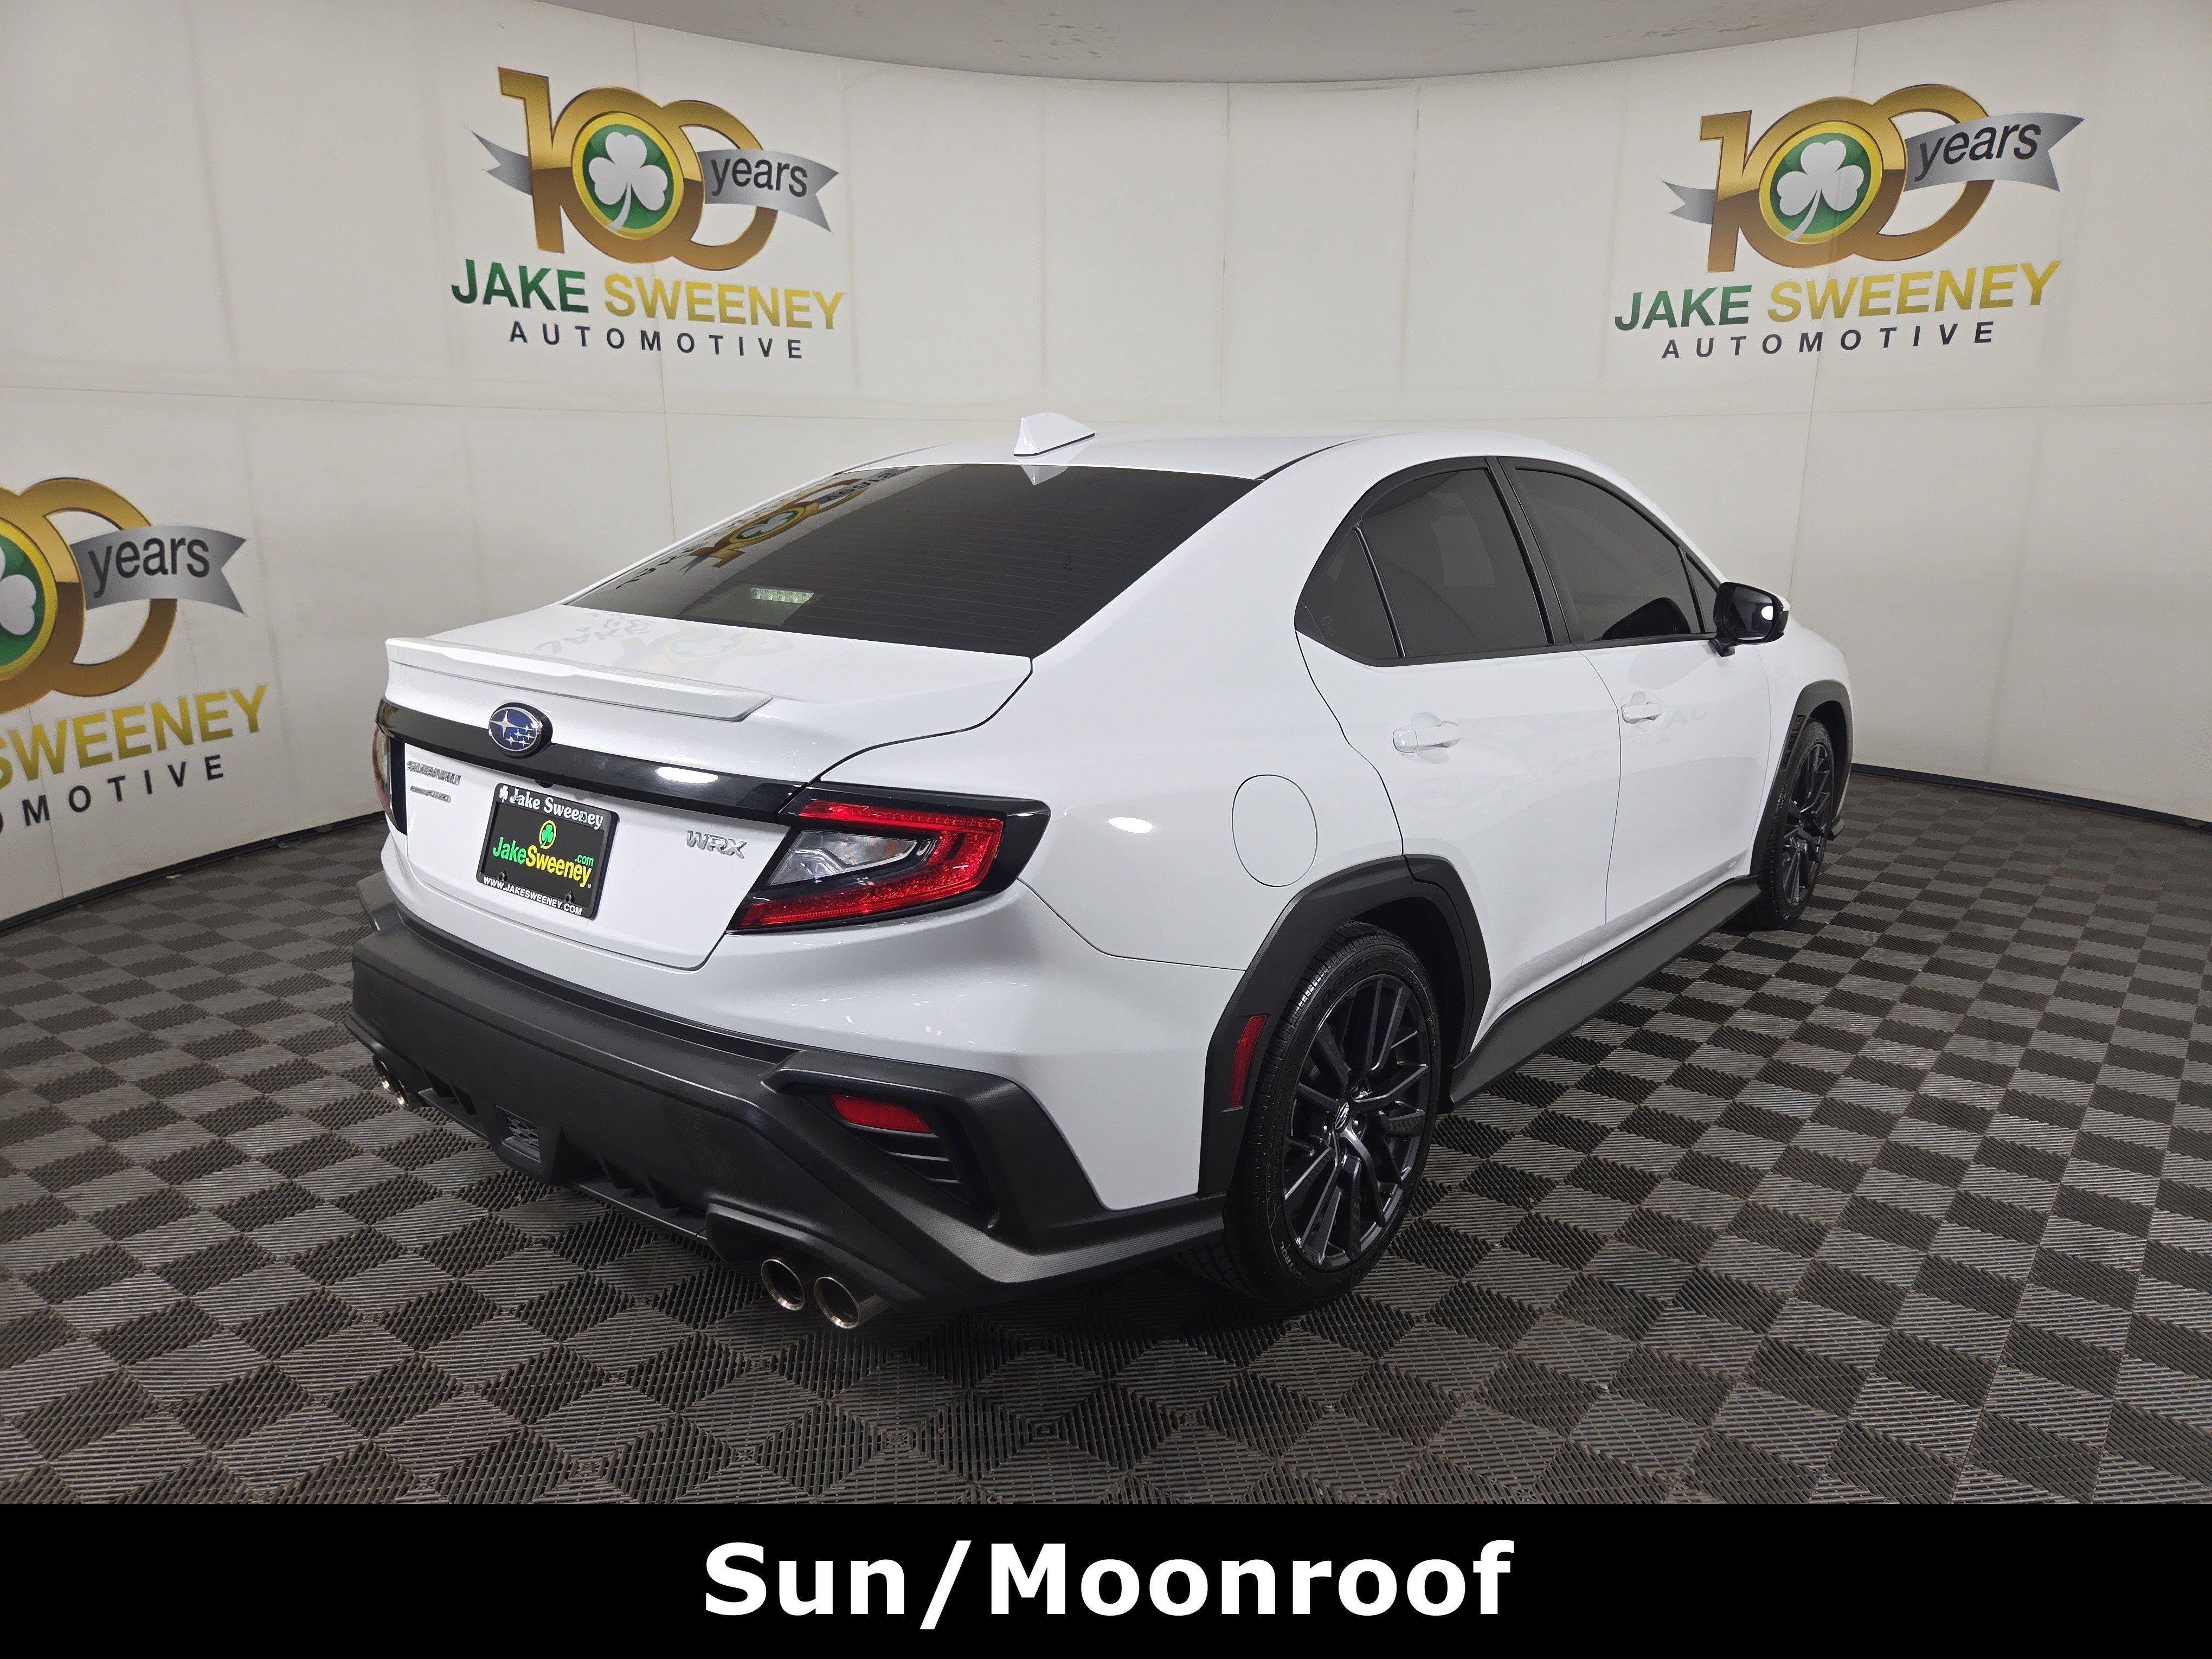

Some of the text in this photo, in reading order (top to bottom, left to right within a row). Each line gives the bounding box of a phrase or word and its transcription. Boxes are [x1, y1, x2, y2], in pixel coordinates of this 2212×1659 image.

[497, 66, 808, 271] 100 years
[1699, 83, 2041, 273] 100 years
[451, 259, 844, 330] JAKE SWEENEY
[1615, 260, 2061, 331] JAKE SWEENEY
[509, 321, 802, 359] AUTOMOTIVE
[1661, 321, 1995, 359] AUTOMOTIVE
[88, 538, 210, 599] years
[0, 754, 224, 834] MOTIVE
[407, 760, 461, 786] SUBARU
[509, 788, 604, 830] Jake Sweeney
[686, 829, 748, 859] WRX
[484, 876, 582, 916] WWW.JAKESWEENEY.COM
